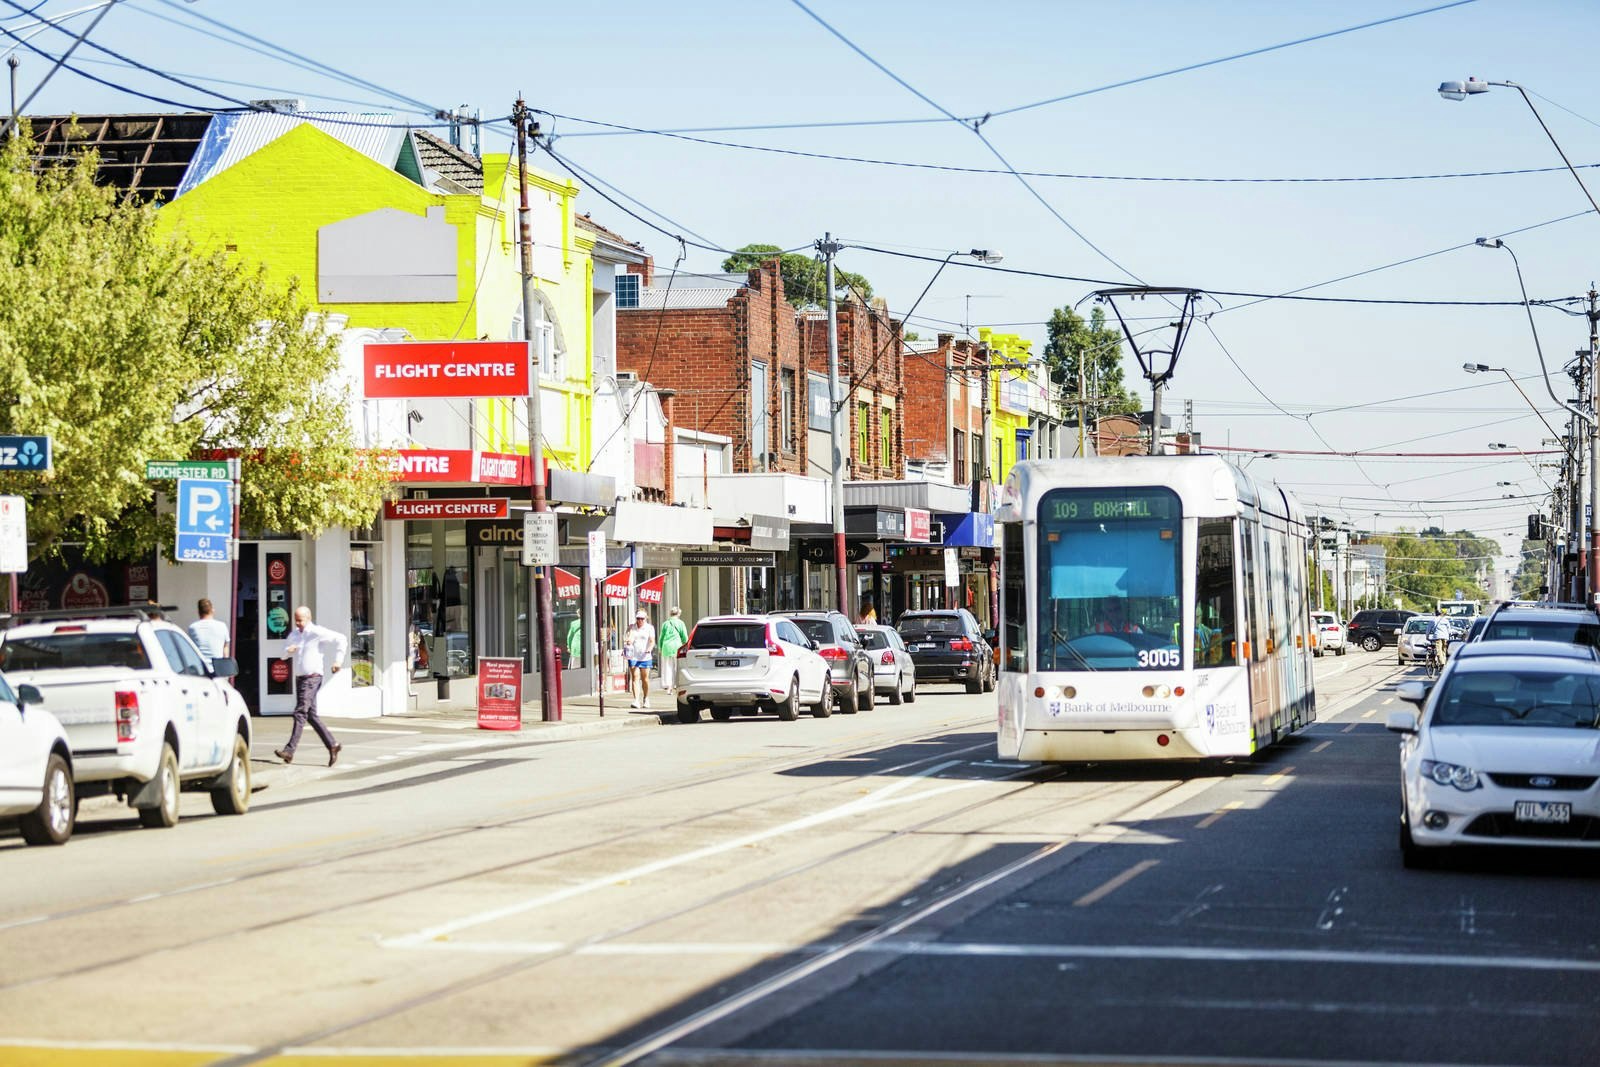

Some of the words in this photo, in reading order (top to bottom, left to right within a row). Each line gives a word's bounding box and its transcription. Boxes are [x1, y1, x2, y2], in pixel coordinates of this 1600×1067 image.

[375, 364, 441, 378] FLIGHT
[443, 363, 516, 377] CENTRE
[0, 447, 18, 465] Z
[148, 467, 208, 479] ROCHESTER
[211, 467, 226, 479] RD
[481, 457, 499, 476] FLIGHT
[499, 459, 517, 478] CENTRE
[189, 487, 221, 526] P
[396, 504, 443, 515] FLIGHT
[445, 503, 497, 514] CENTRE
[1054, 502, 1078, 518] 109
[1093, 501, 1119, 517] BOX
[1123, 500, 1151, 516] HILL
[198, 537, 211, 548] 61
[183, 548, 224, 558] SPACES
[605, 584, 627, 597] OPEN
[640, 588, 661, 601] OPEN
[1138, 648, 1180, 667] 3005
[1064, 702, 1093, 713] Bank
[1095, 702, 1106, 712] of
[1110, 702, 1173, 712] Melbourne
[1516, 804, 1538, 817] YUL
[1547, 805, 1568, 817] 555
